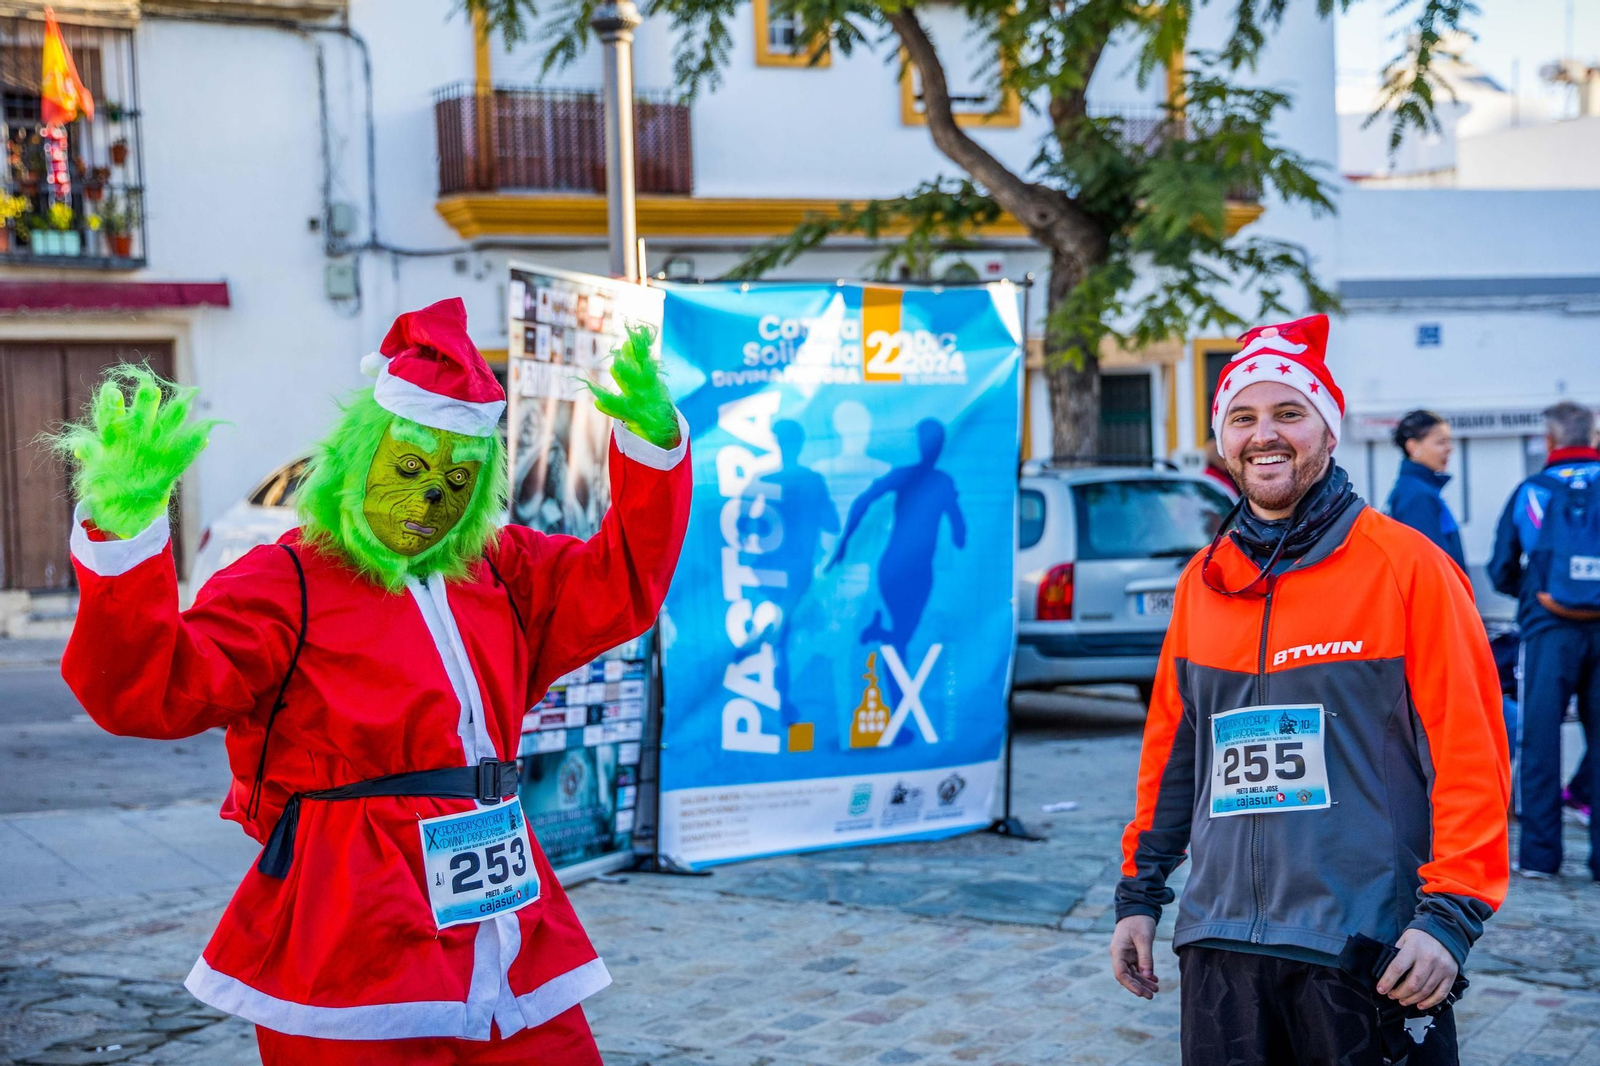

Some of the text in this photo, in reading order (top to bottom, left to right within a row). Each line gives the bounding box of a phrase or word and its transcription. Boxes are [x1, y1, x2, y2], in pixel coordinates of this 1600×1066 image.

[866, 330, 912, 373] 22
[904, 351, 966, 374] 2024
[716, 391, 787, 754] PASTORA
[877, 643, 943, 748] X
[1223, 742, 1306, 786] 255
[1236, 795, 1274, 808] cajasur
[1265, 785, 1279, 793] JOSE
[449, 837, 527, 894] 253
[479, 893, 517, 913] cajasur
[503, 884, 514, 894] JOSE
